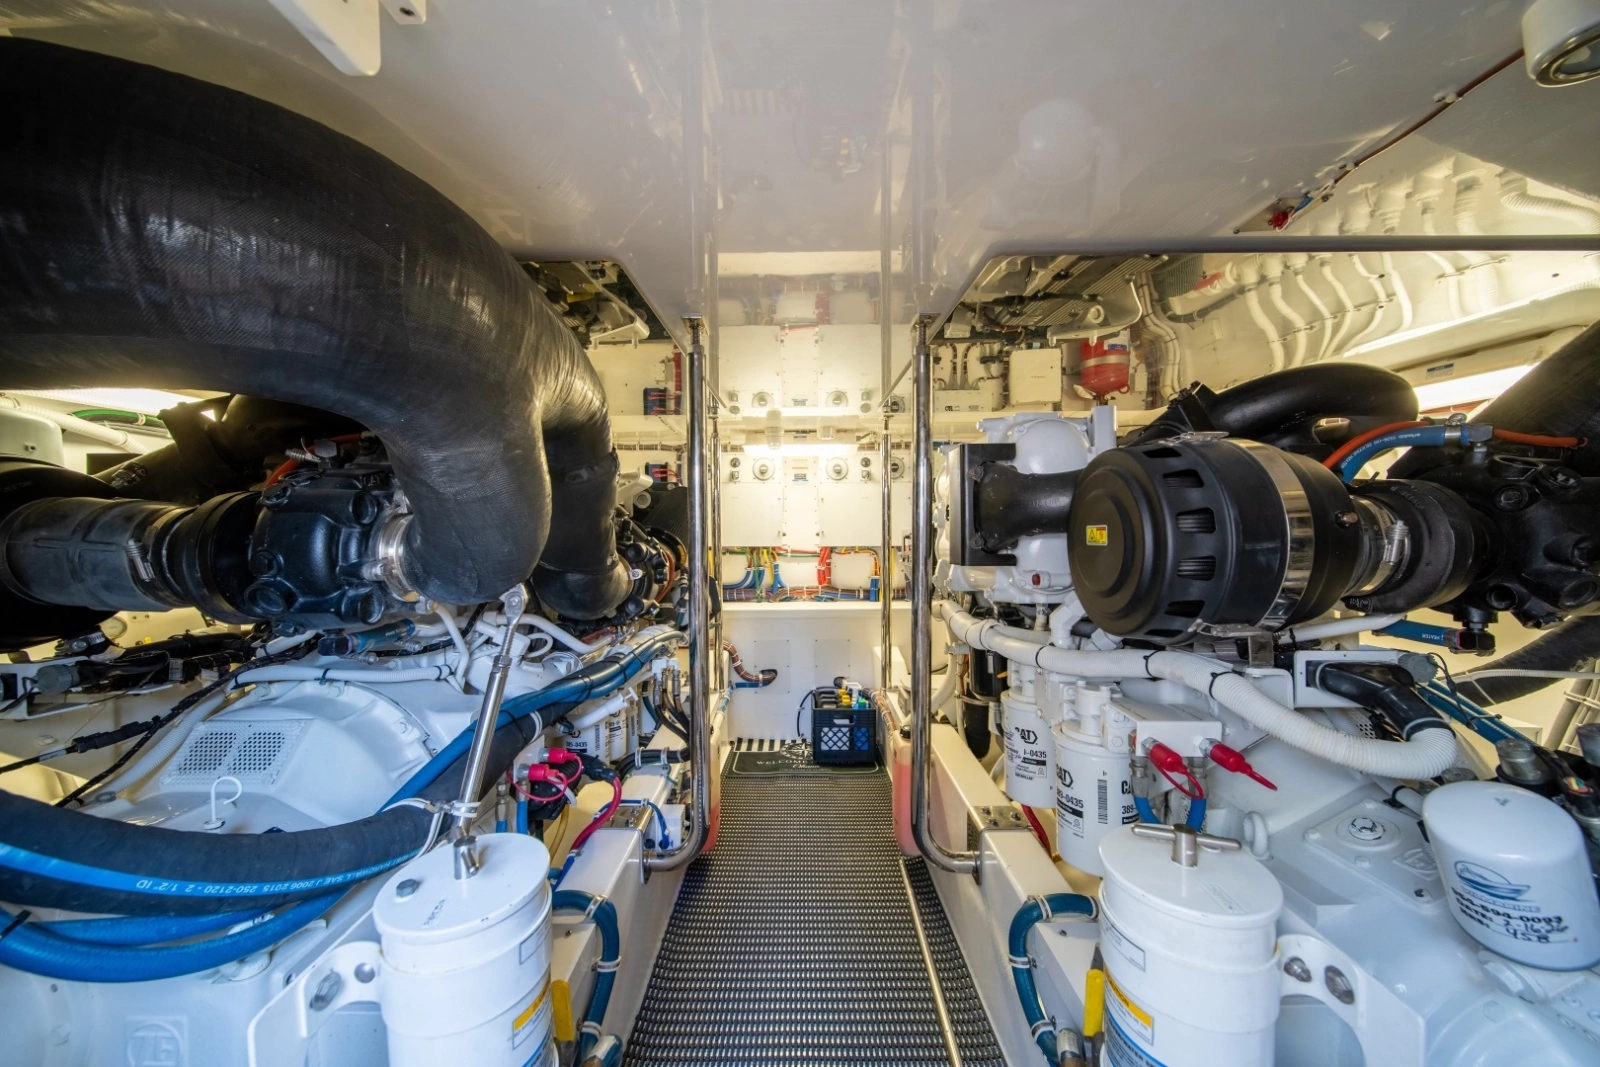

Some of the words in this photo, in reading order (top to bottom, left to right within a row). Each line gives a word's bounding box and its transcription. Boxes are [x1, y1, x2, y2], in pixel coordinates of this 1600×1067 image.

[135, 878, 152, 890] ID
[323, 873, 344, 886] SAE
[184, 883, 195, 893] 2
[203, 883, 258, 894] 250-2120
[262, 882, 288, 892] 2015
[290, 880, 315, 891] 2006
